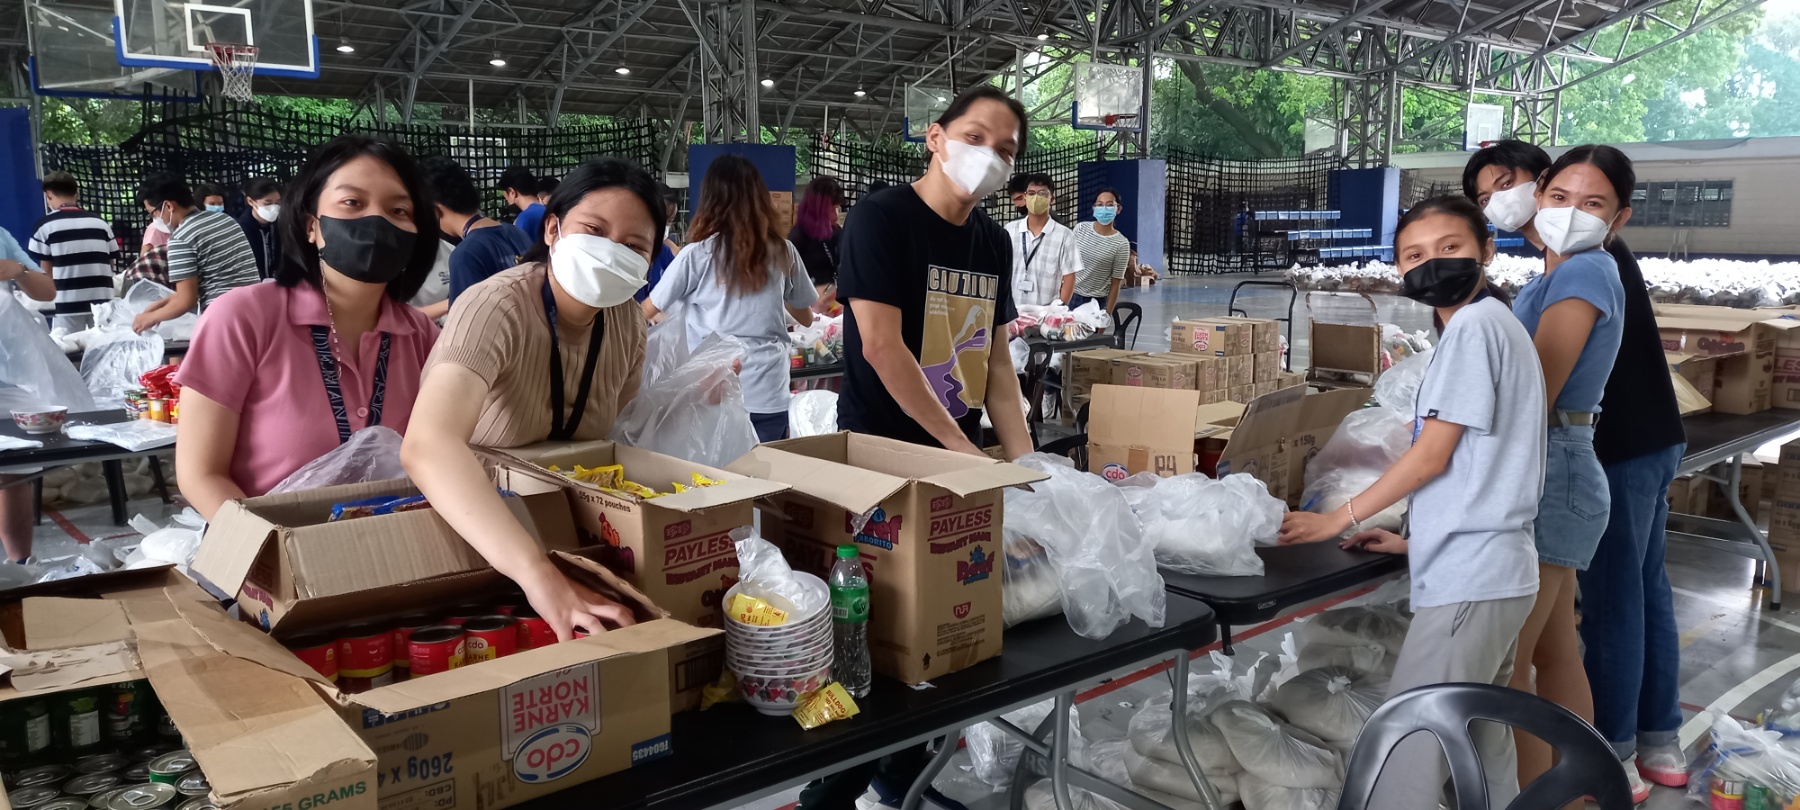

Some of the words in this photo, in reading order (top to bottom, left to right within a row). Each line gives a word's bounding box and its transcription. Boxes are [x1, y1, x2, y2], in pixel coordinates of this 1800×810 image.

[1301, 434, 1316, 446] 150g
[1105, 469, 1126, 480] cdo
[595, 496, 604, 506] 72
[604, 500, 631, 513] pouches
[929, 508, 992, 537] PAYLESS
[467, 640, 484, 649] cdo
[512, 675, 588, 713] NORTE
[825, 689, 846, 714] BULLDOG
[513, 695, 589, 734] KARNE
[526, 738, 581, 772] cdo
[632, 740, 668, 761] FG04435
[408, 752, 454, 780] 260g
[297, 781, 367, 810] GRAMS
[425, 784, 452, 797] CBD:
[434, 796, 453, 807] PD:
